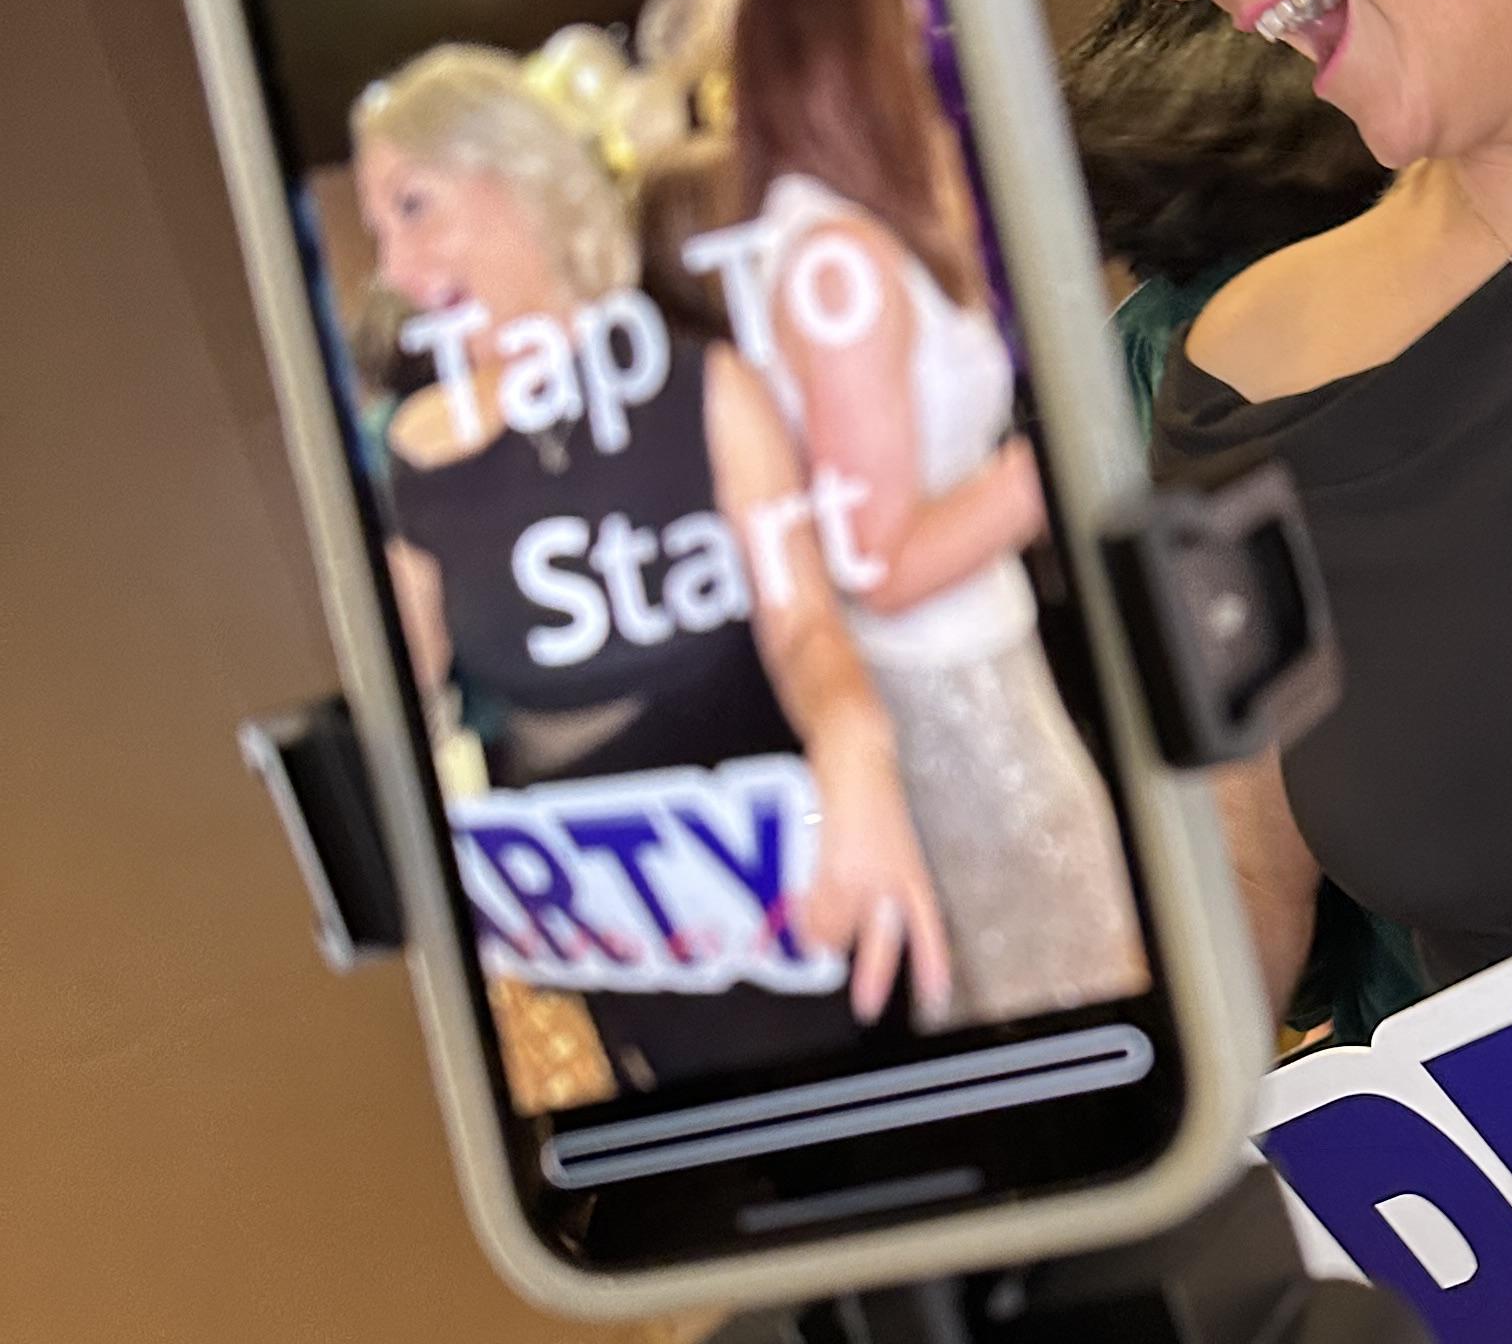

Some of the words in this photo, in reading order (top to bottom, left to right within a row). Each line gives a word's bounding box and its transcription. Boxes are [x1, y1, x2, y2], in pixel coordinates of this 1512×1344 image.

[400, 286, 672, 454] Tap
[681, 212, 886, 370] To
[511, 462, 891, 666] Start
